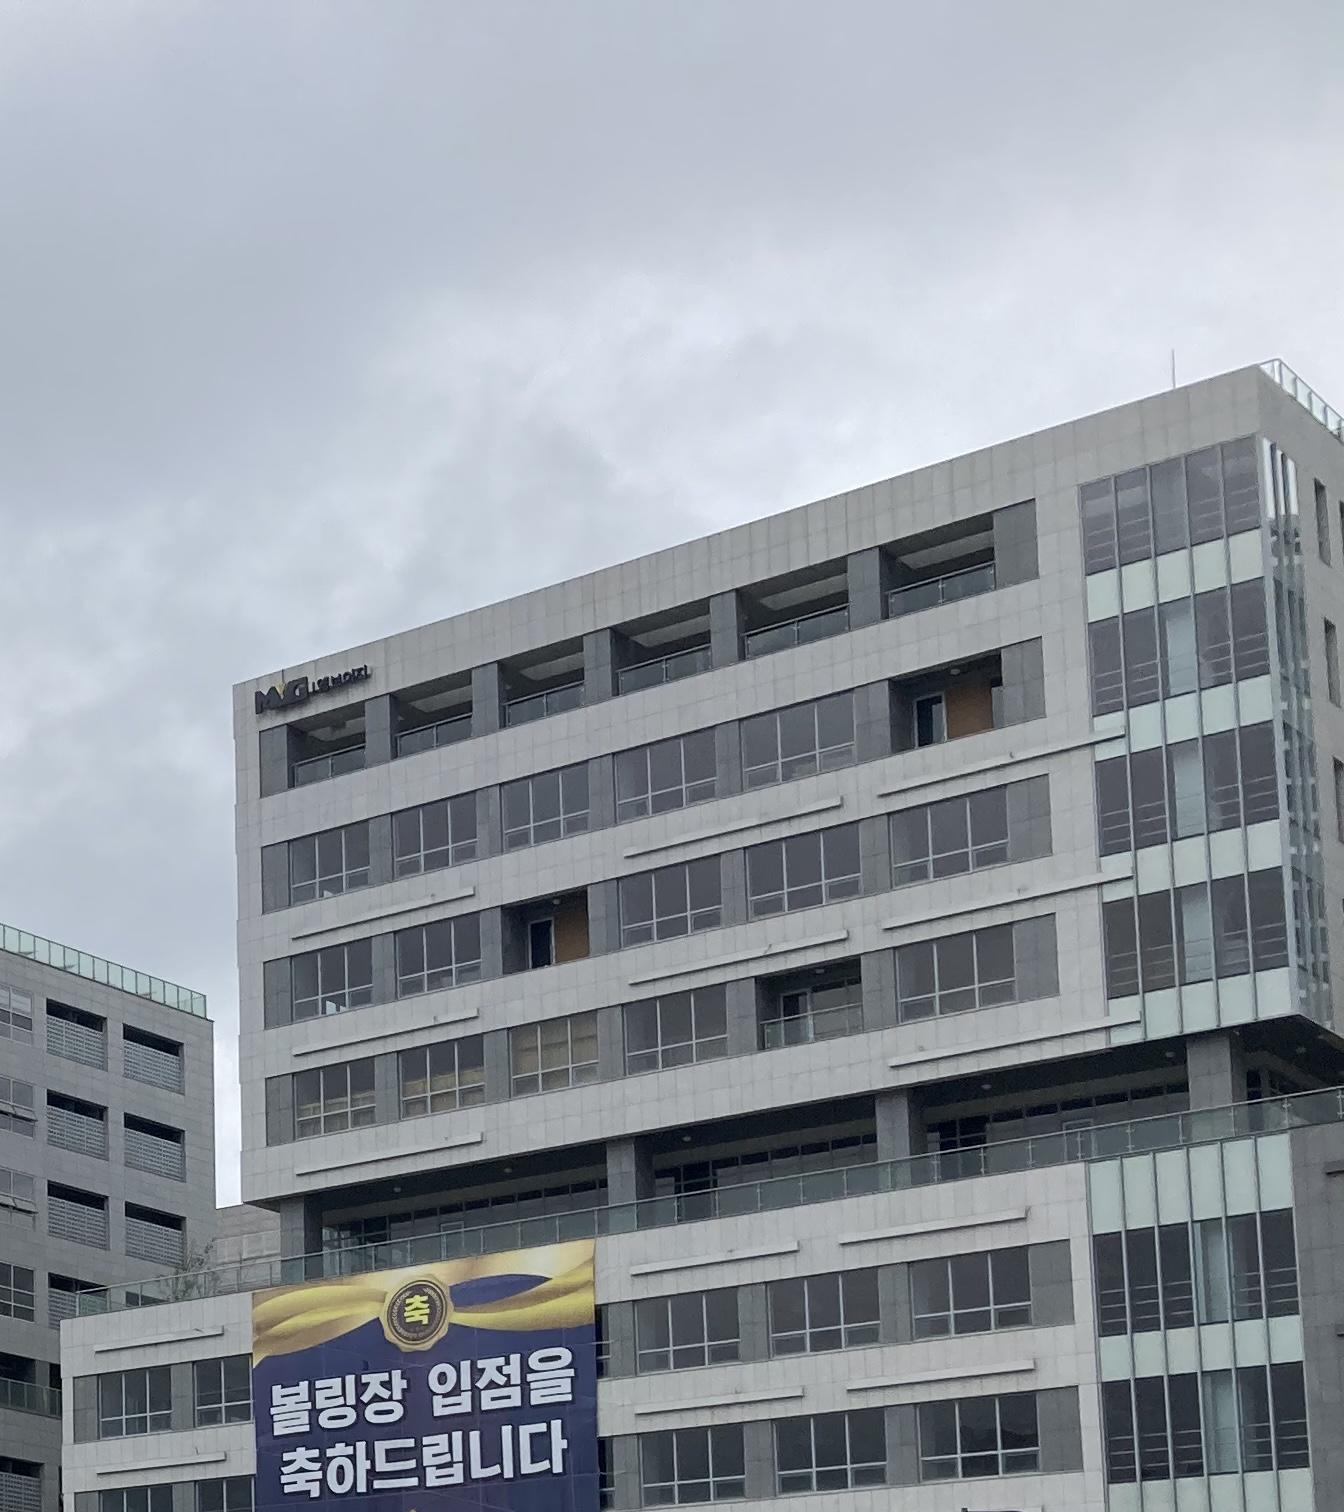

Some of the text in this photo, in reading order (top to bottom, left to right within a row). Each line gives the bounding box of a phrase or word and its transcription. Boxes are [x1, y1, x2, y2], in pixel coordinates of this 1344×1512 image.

[404, 1294, 430, 1326] 축
[270, 1347, 576, 1437] 볼링장 입점을
[280, 1419, 568, 1498] 축하드립니다
